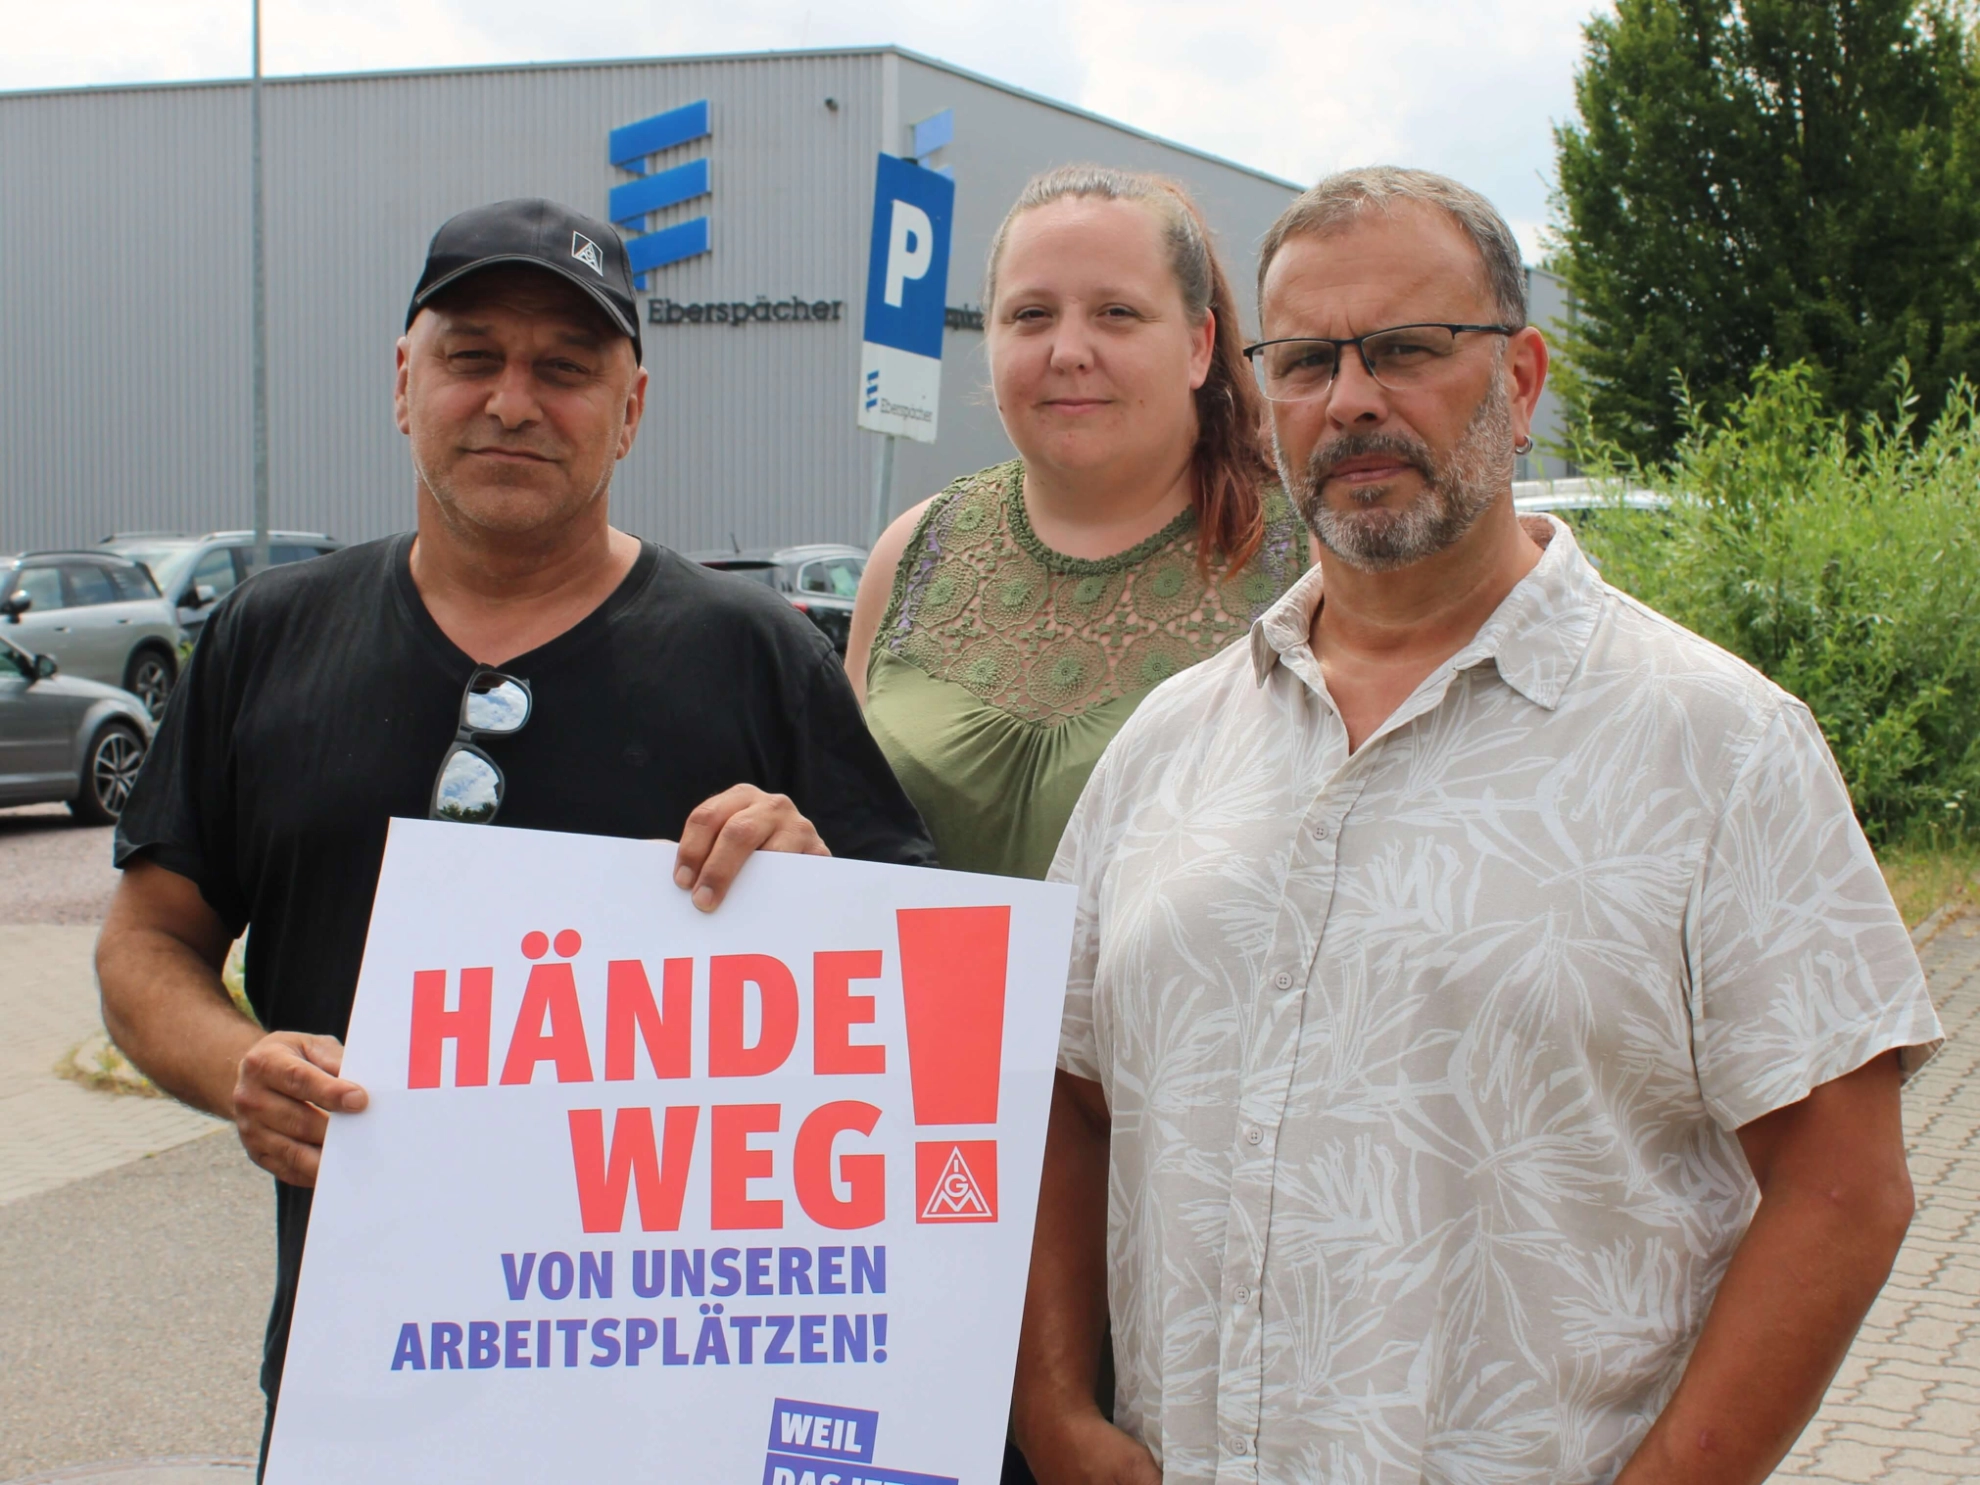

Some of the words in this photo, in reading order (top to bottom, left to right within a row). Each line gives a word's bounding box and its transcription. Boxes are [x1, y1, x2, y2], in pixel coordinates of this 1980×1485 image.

[884, 199, 933, 308] P
[648, 295, 843, 327] Eberspächer
[407, 928, 886, 1090] HÄNDE
[567, 1099, 886, 1234] WEG
[500, 1250, 614, 1301] VON
[632, 1245, 887, 1298] UNSEREN
[390, 1302, 888, 1371] ARBEITSPLÄTZEN!
[781, 1411, 862, 1453] WEIL
